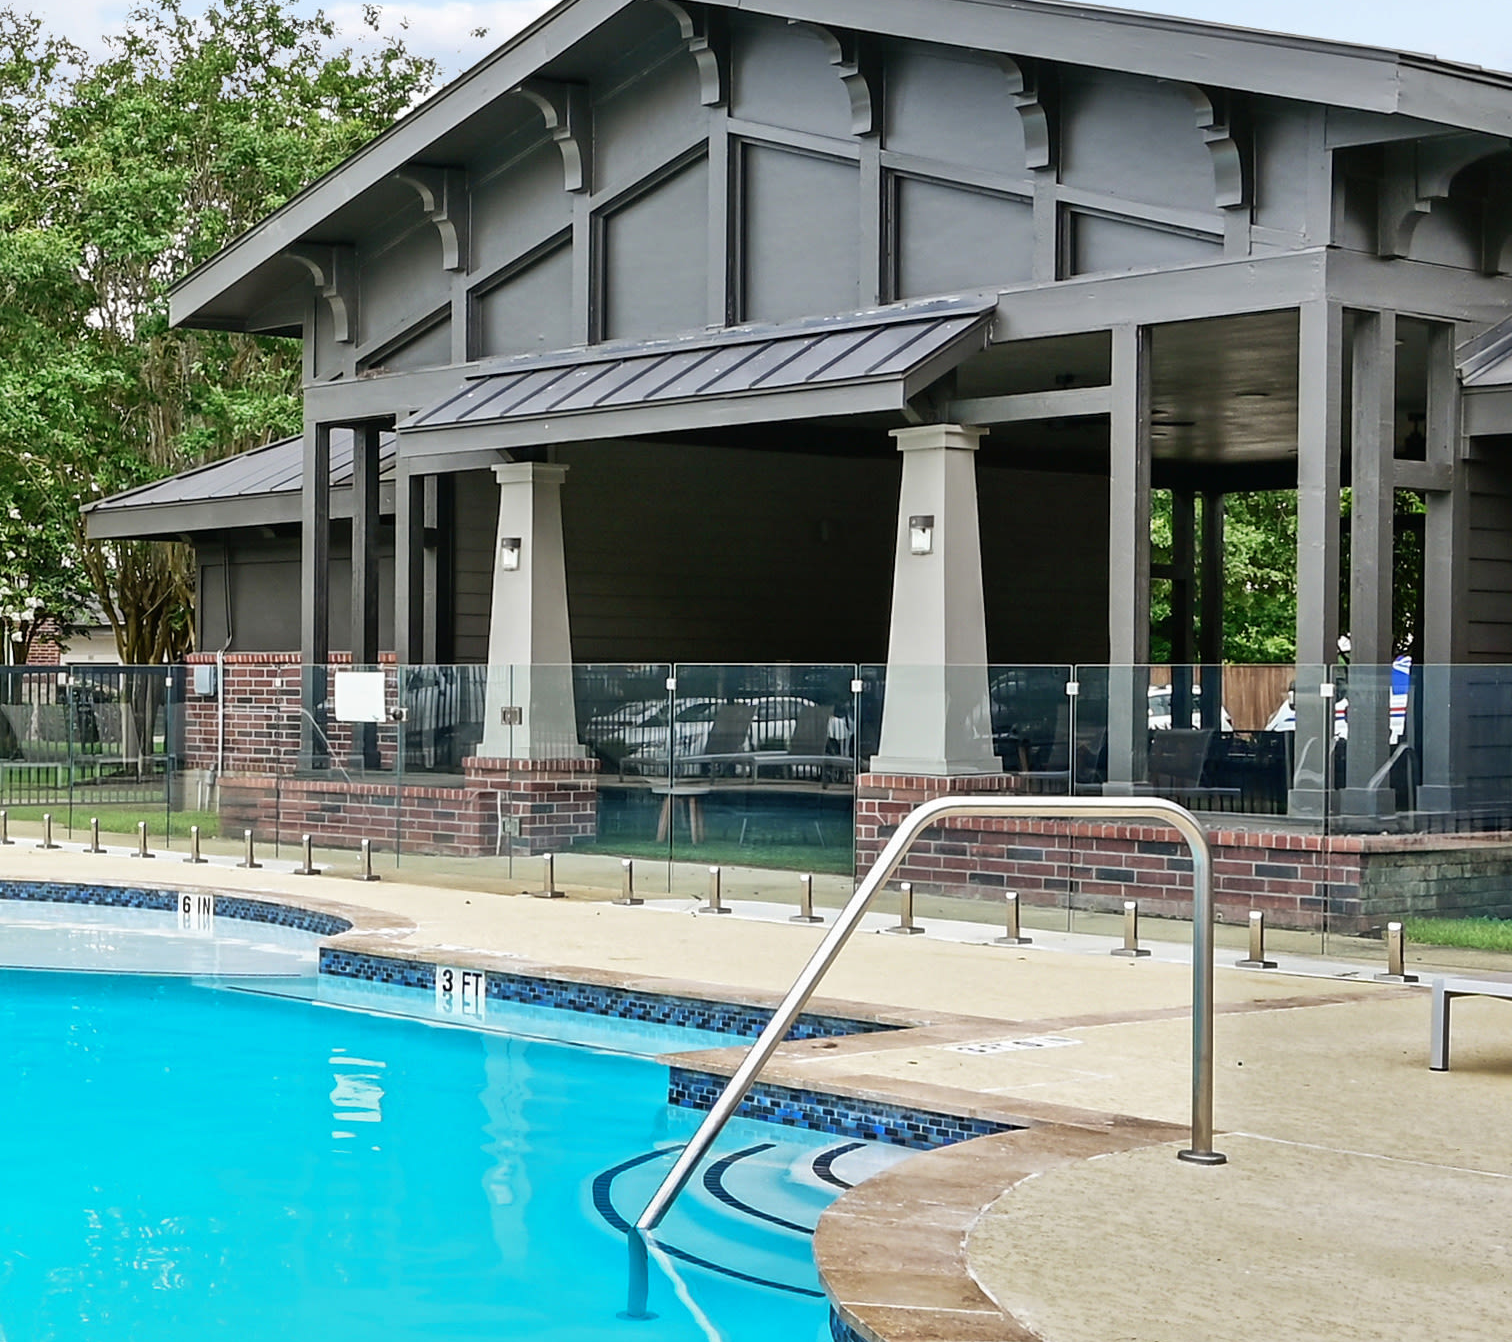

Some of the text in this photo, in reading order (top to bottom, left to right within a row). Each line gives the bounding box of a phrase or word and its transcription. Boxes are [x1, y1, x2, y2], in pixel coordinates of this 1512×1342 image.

[183, 895, 211, 915] 6 IN
[442, 969, 483, 996] 3 FT
